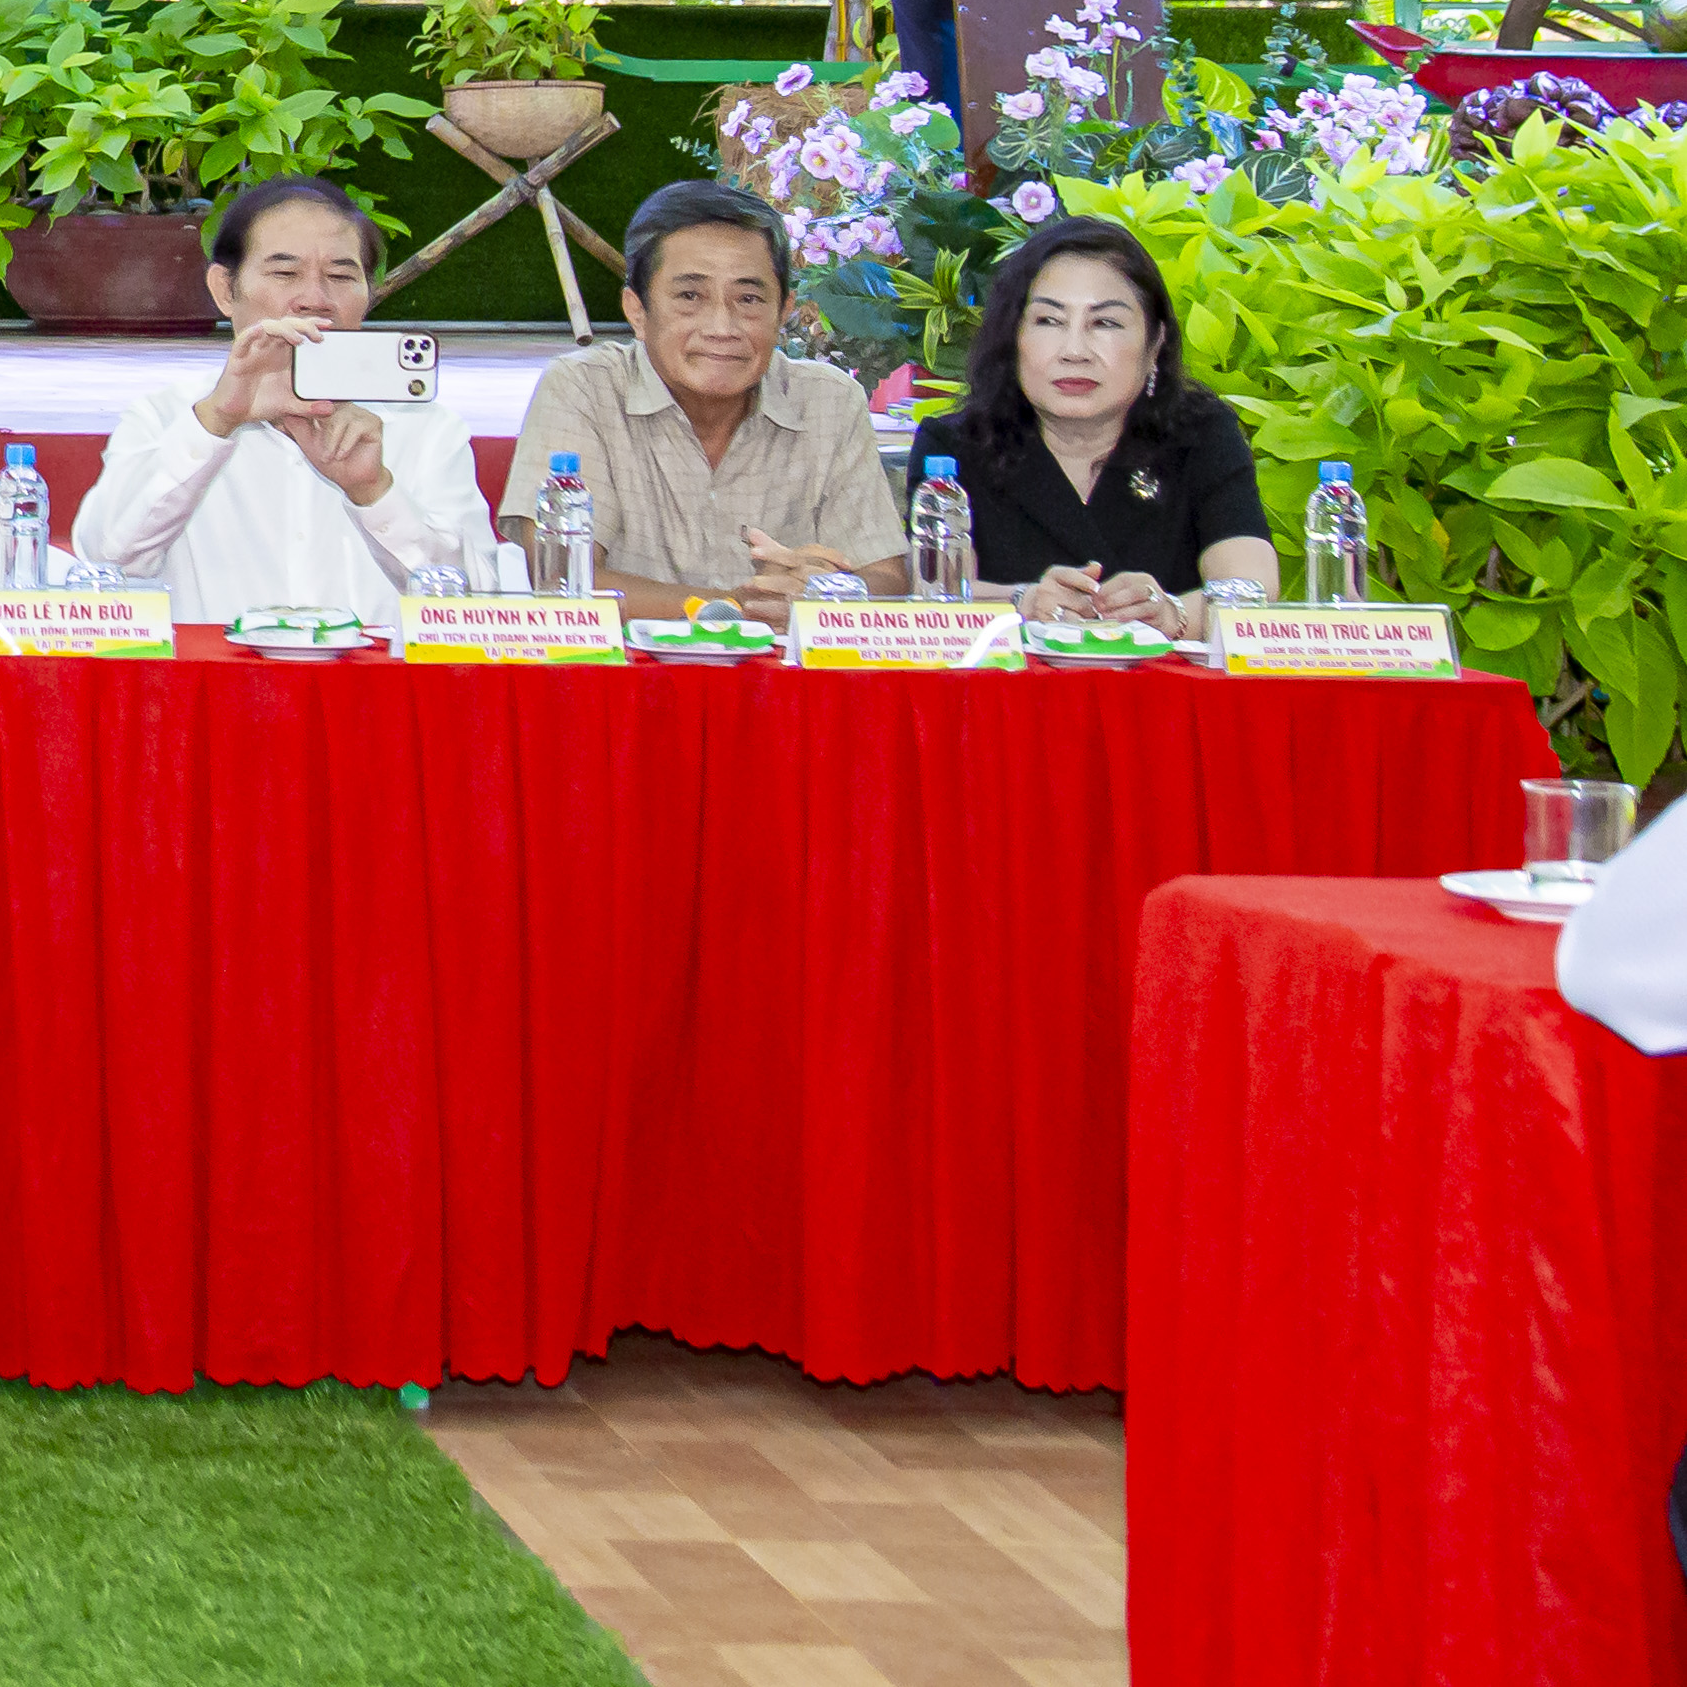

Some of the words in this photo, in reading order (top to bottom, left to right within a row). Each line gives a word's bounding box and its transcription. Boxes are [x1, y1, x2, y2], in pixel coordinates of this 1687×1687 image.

[33, 600, 53, 620] LÊ
[420, 605, 457, 626] ÔNG
[462, 606, 522, 626] HUỲNH
[818, 608, 855, 629] ÔNG
[860, 609, 910, 633] ĐẶNG
[1374, 624, 1405, 642] LAN
[1407, 624, 1434, 642] CHI
